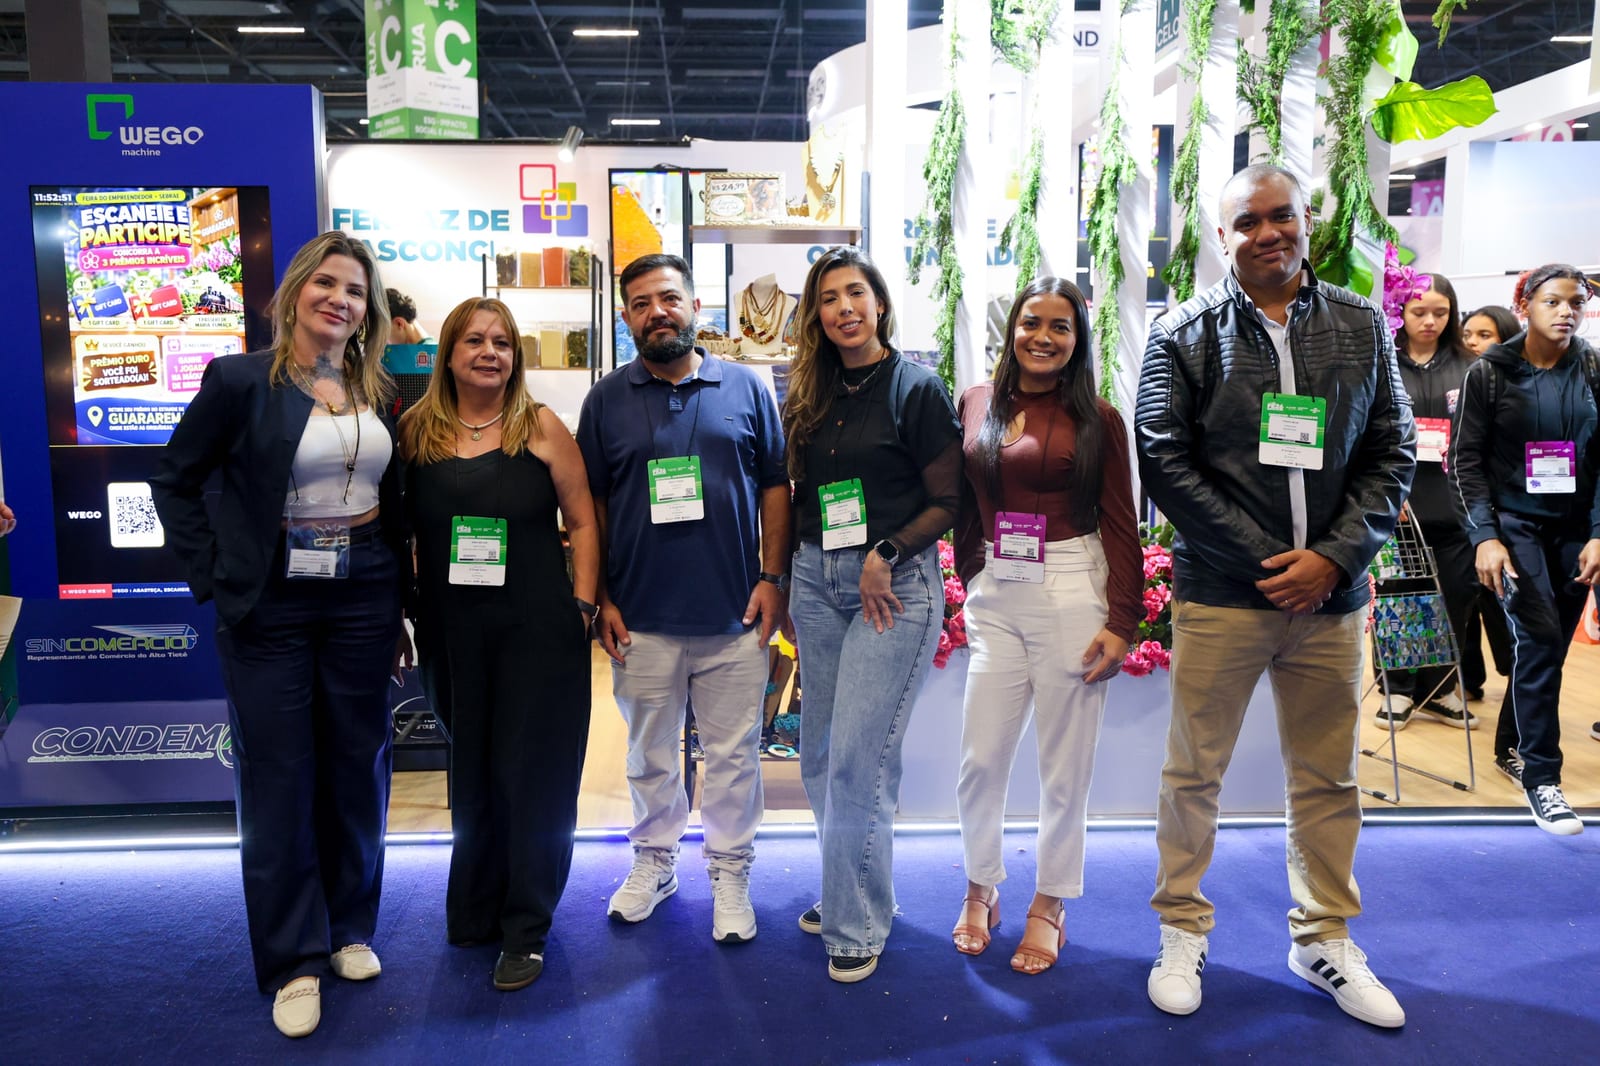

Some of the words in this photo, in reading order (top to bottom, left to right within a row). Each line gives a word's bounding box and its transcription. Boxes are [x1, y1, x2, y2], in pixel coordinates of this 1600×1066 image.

[411, 23, 426, 69] RUA
[434, 20, 473, 78] C
[119, 126, 204, 145] WEGO
[121, 148, 161, 157] machine
[34, 193, 72, 202] 11:52:51
[80, 206, 175, 226] ESCANEIE
[176, 206, 189, 220] E
[468, 209, 510, 231] DE
[79, 222, 192, 249] PARTICIPE
[102, 259, 109, 267] 3
[109, 257, 146, 266] PRÊMIOS
[146, 254, 186, 264] INCRÍVEIS
[90, 357, 124, 368] PRÊMIO
[125, 354, 150, 364] OURO
[102, 367, 124, 377] VOCÊ
[125, 365, 139, 375] FOI
[108, 412, 183, 425] GUARAREM
[67, 511, 102, 519] WEGO
[25, 636, 188, 653] SINCOMERCIO
[27, 654, 86, 662] Representante
[32, 723, 225, 755] CONDEM
